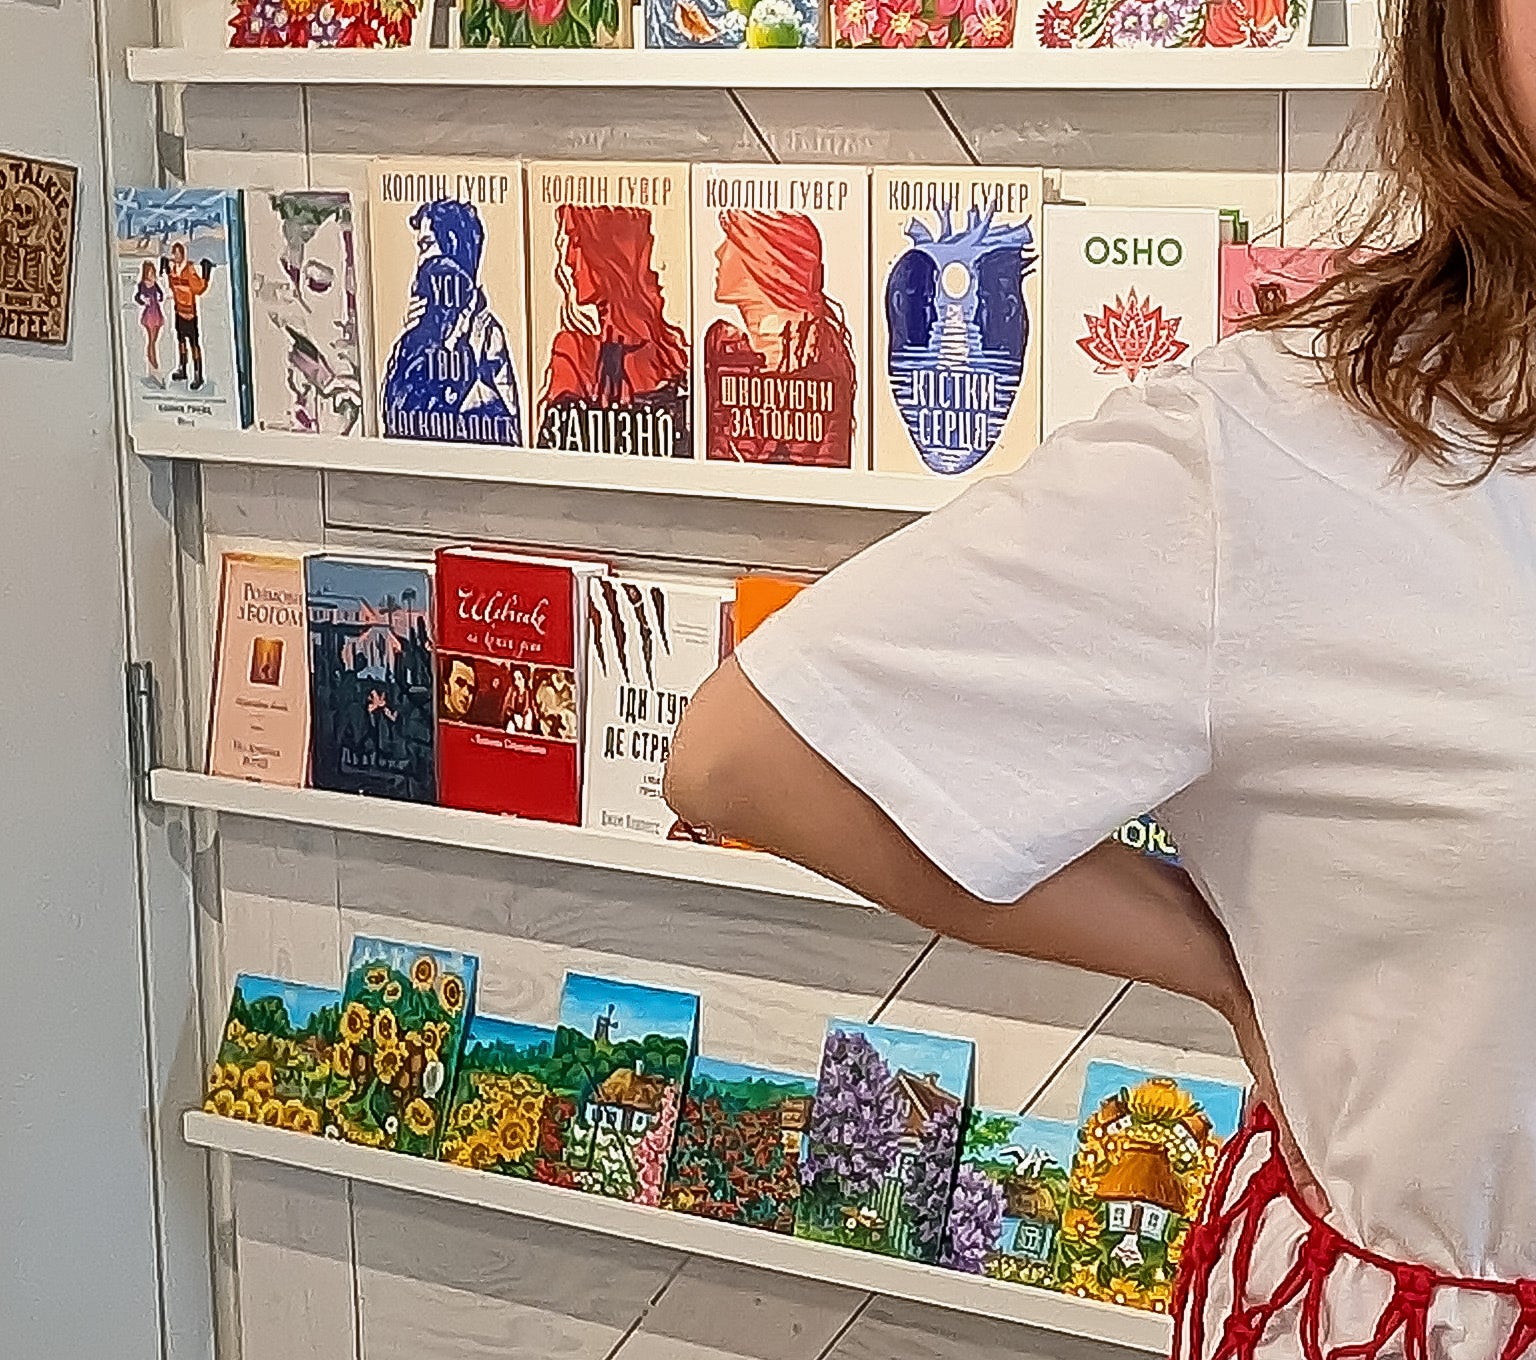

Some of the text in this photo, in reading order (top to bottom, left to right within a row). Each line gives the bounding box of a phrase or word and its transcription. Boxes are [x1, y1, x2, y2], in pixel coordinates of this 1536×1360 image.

[382, 173, 509, 204] КОЛЛІН ГУВЕР
[541, 175, 672, 205] КОЛЛІН ГУВЕР
[706, 178, 849, 211] КОЛЛІН ГУВЕР
[889, 181, 1029, 213] КОЛЛІН ГУВЕР
[1084, 236, 1183, 267] OSHO
[430, 274, 461, 308] УСІ
[912, 369, 995, 413] КІСТКИ
[546, 405, 674, 458] ЗАПІЗНО
[731, 408, 824, 442] ЗА ТОБОЮ
[919, 408, 989, 452] СЕРЦЯ
[603, 726, 671, 763] ДЕ СТРА
